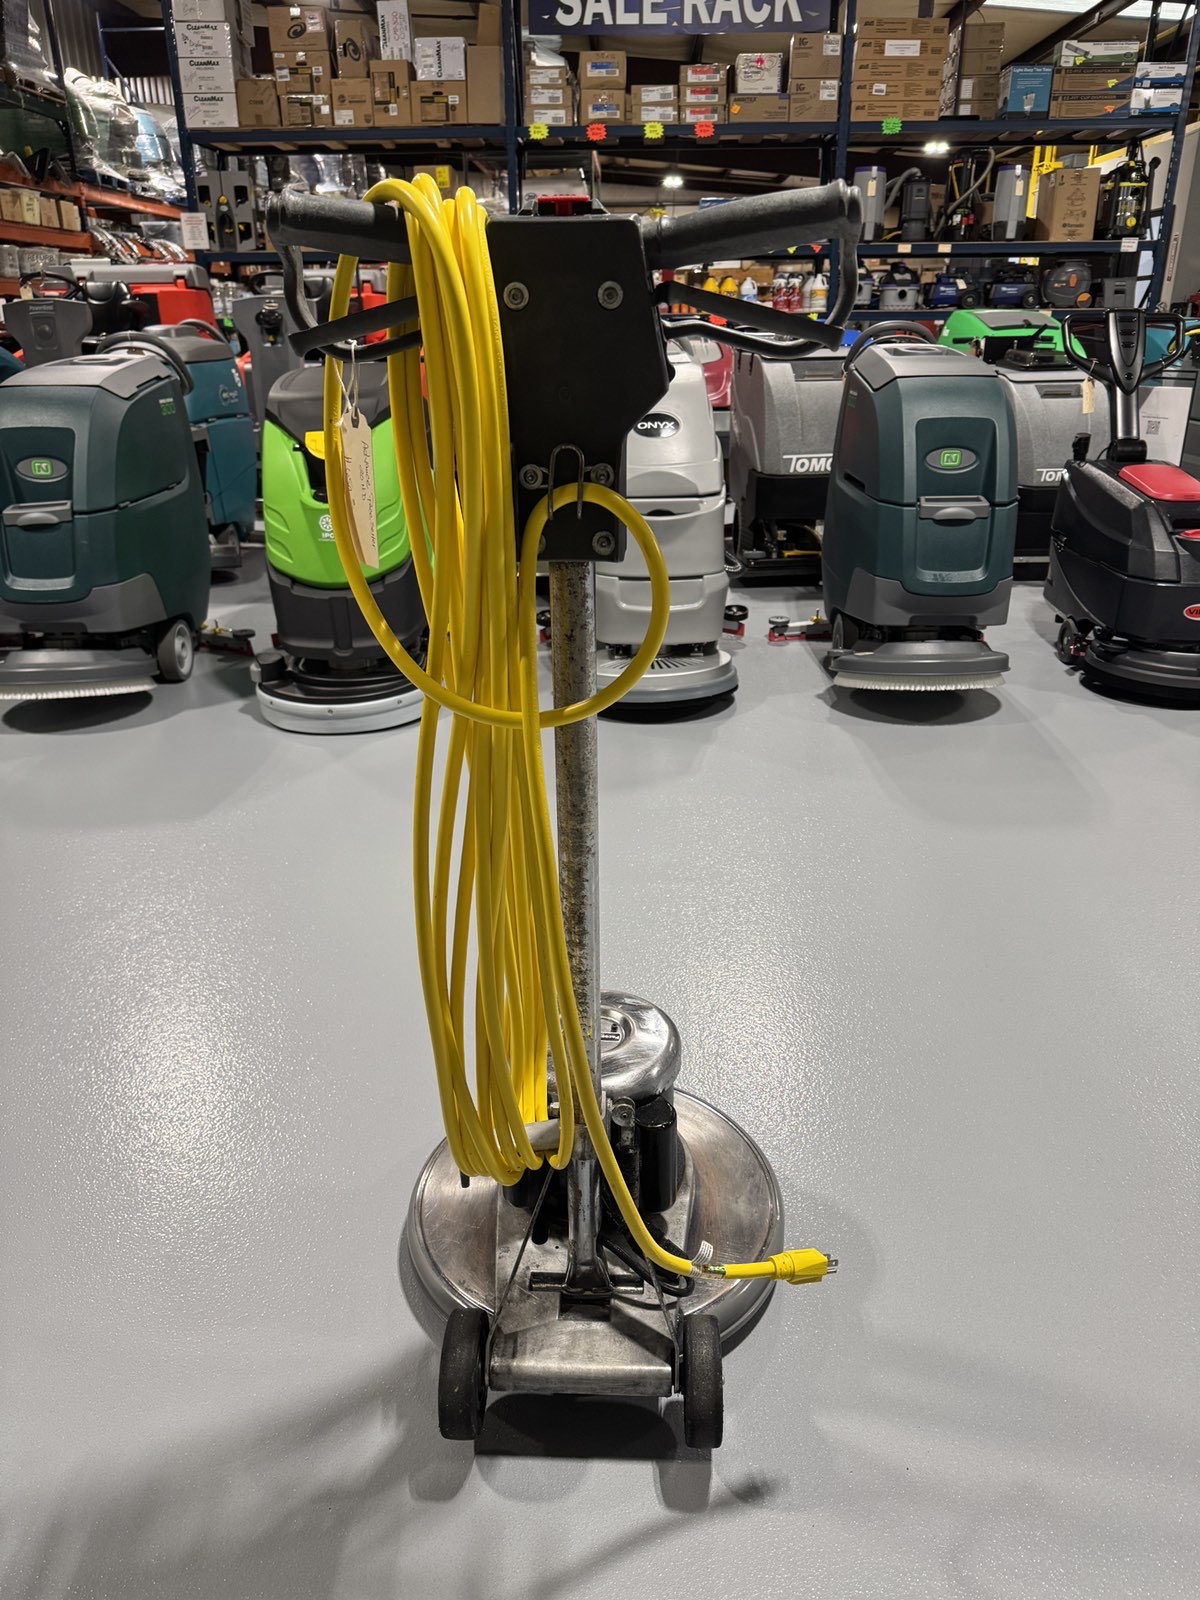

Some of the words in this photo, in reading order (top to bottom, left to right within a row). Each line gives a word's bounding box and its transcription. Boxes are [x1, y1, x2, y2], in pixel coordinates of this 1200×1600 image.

[554, 0, 668, 26] SALE
[683, 0, 803, 25] RACK
[637, 421, 676, 430] ONYX
